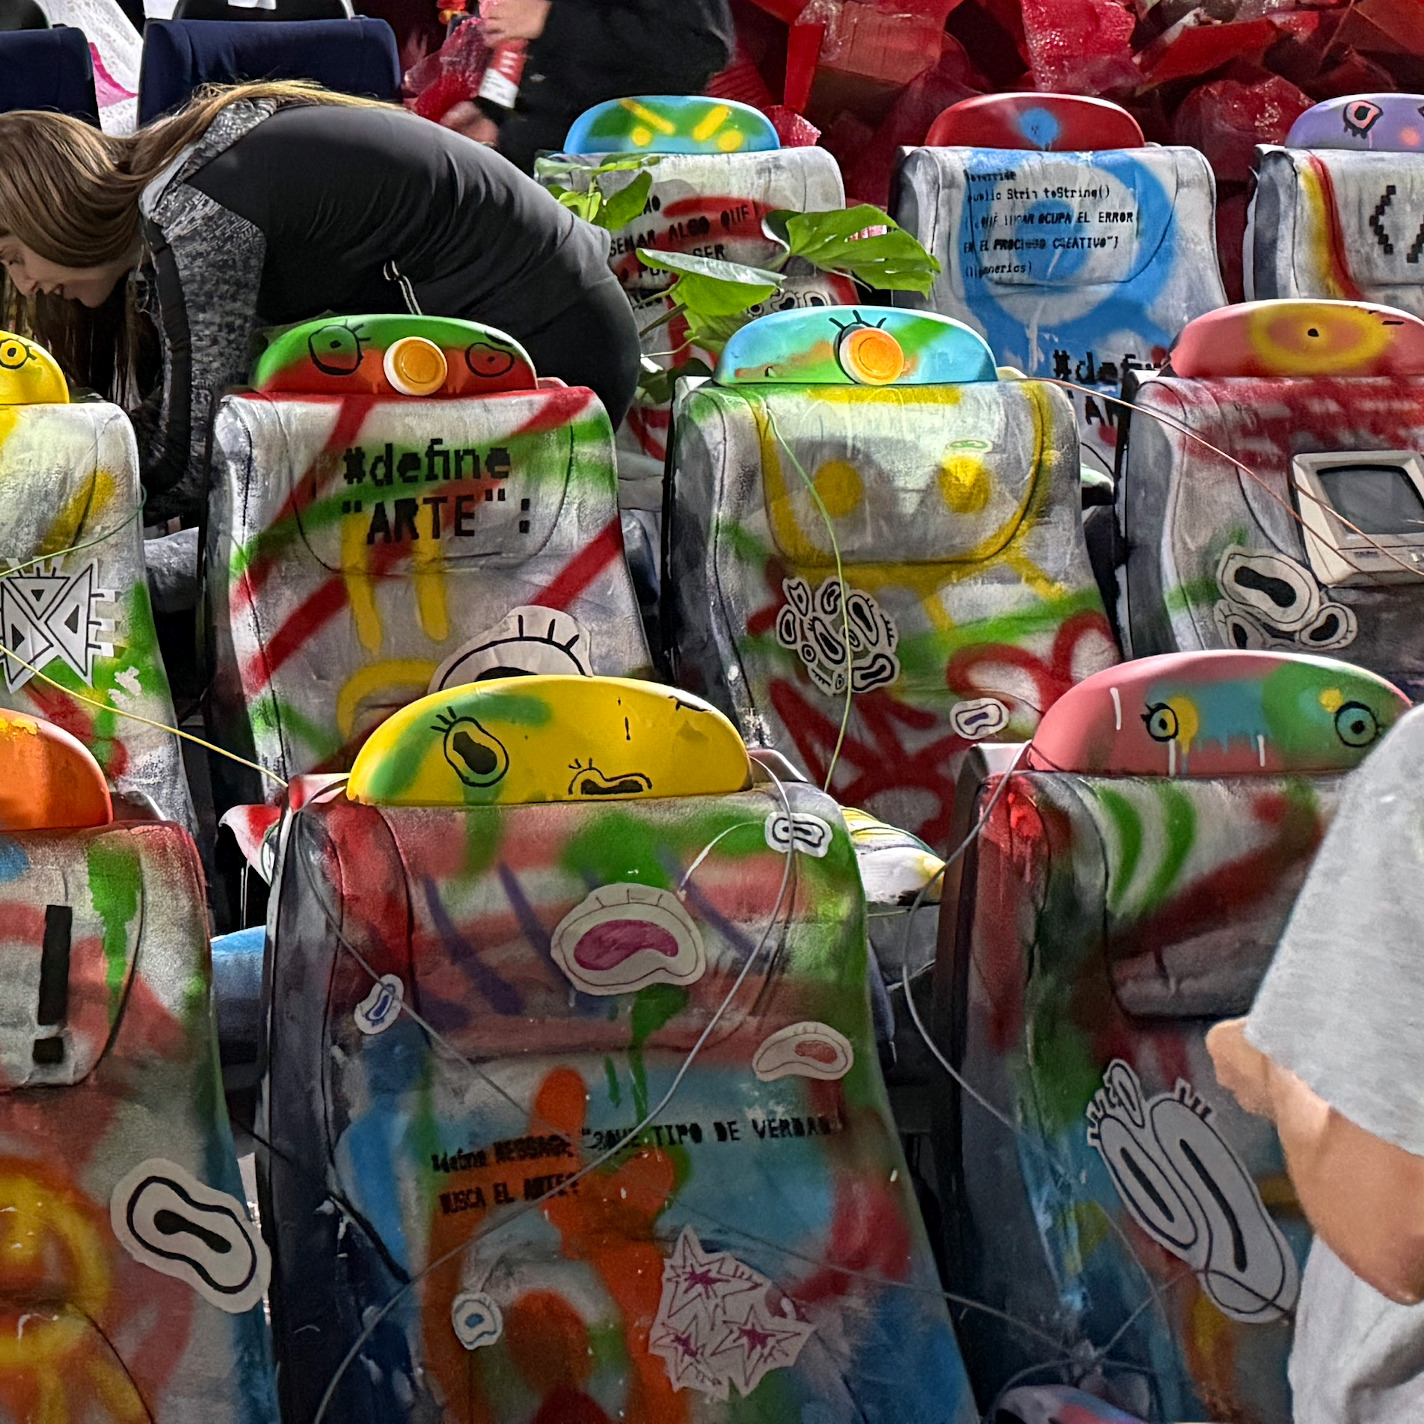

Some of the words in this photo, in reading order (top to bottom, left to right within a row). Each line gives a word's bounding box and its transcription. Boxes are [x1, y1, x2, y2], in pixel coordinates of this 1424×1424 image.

[1078, 211, 1090, 224] EL
[1098, 211, 1134, 224] ERROR
[343, 438, 511, 487] #define
[654, 1122, 703, 1147] TIPO
[713, 1120, 741, 1142] DE
